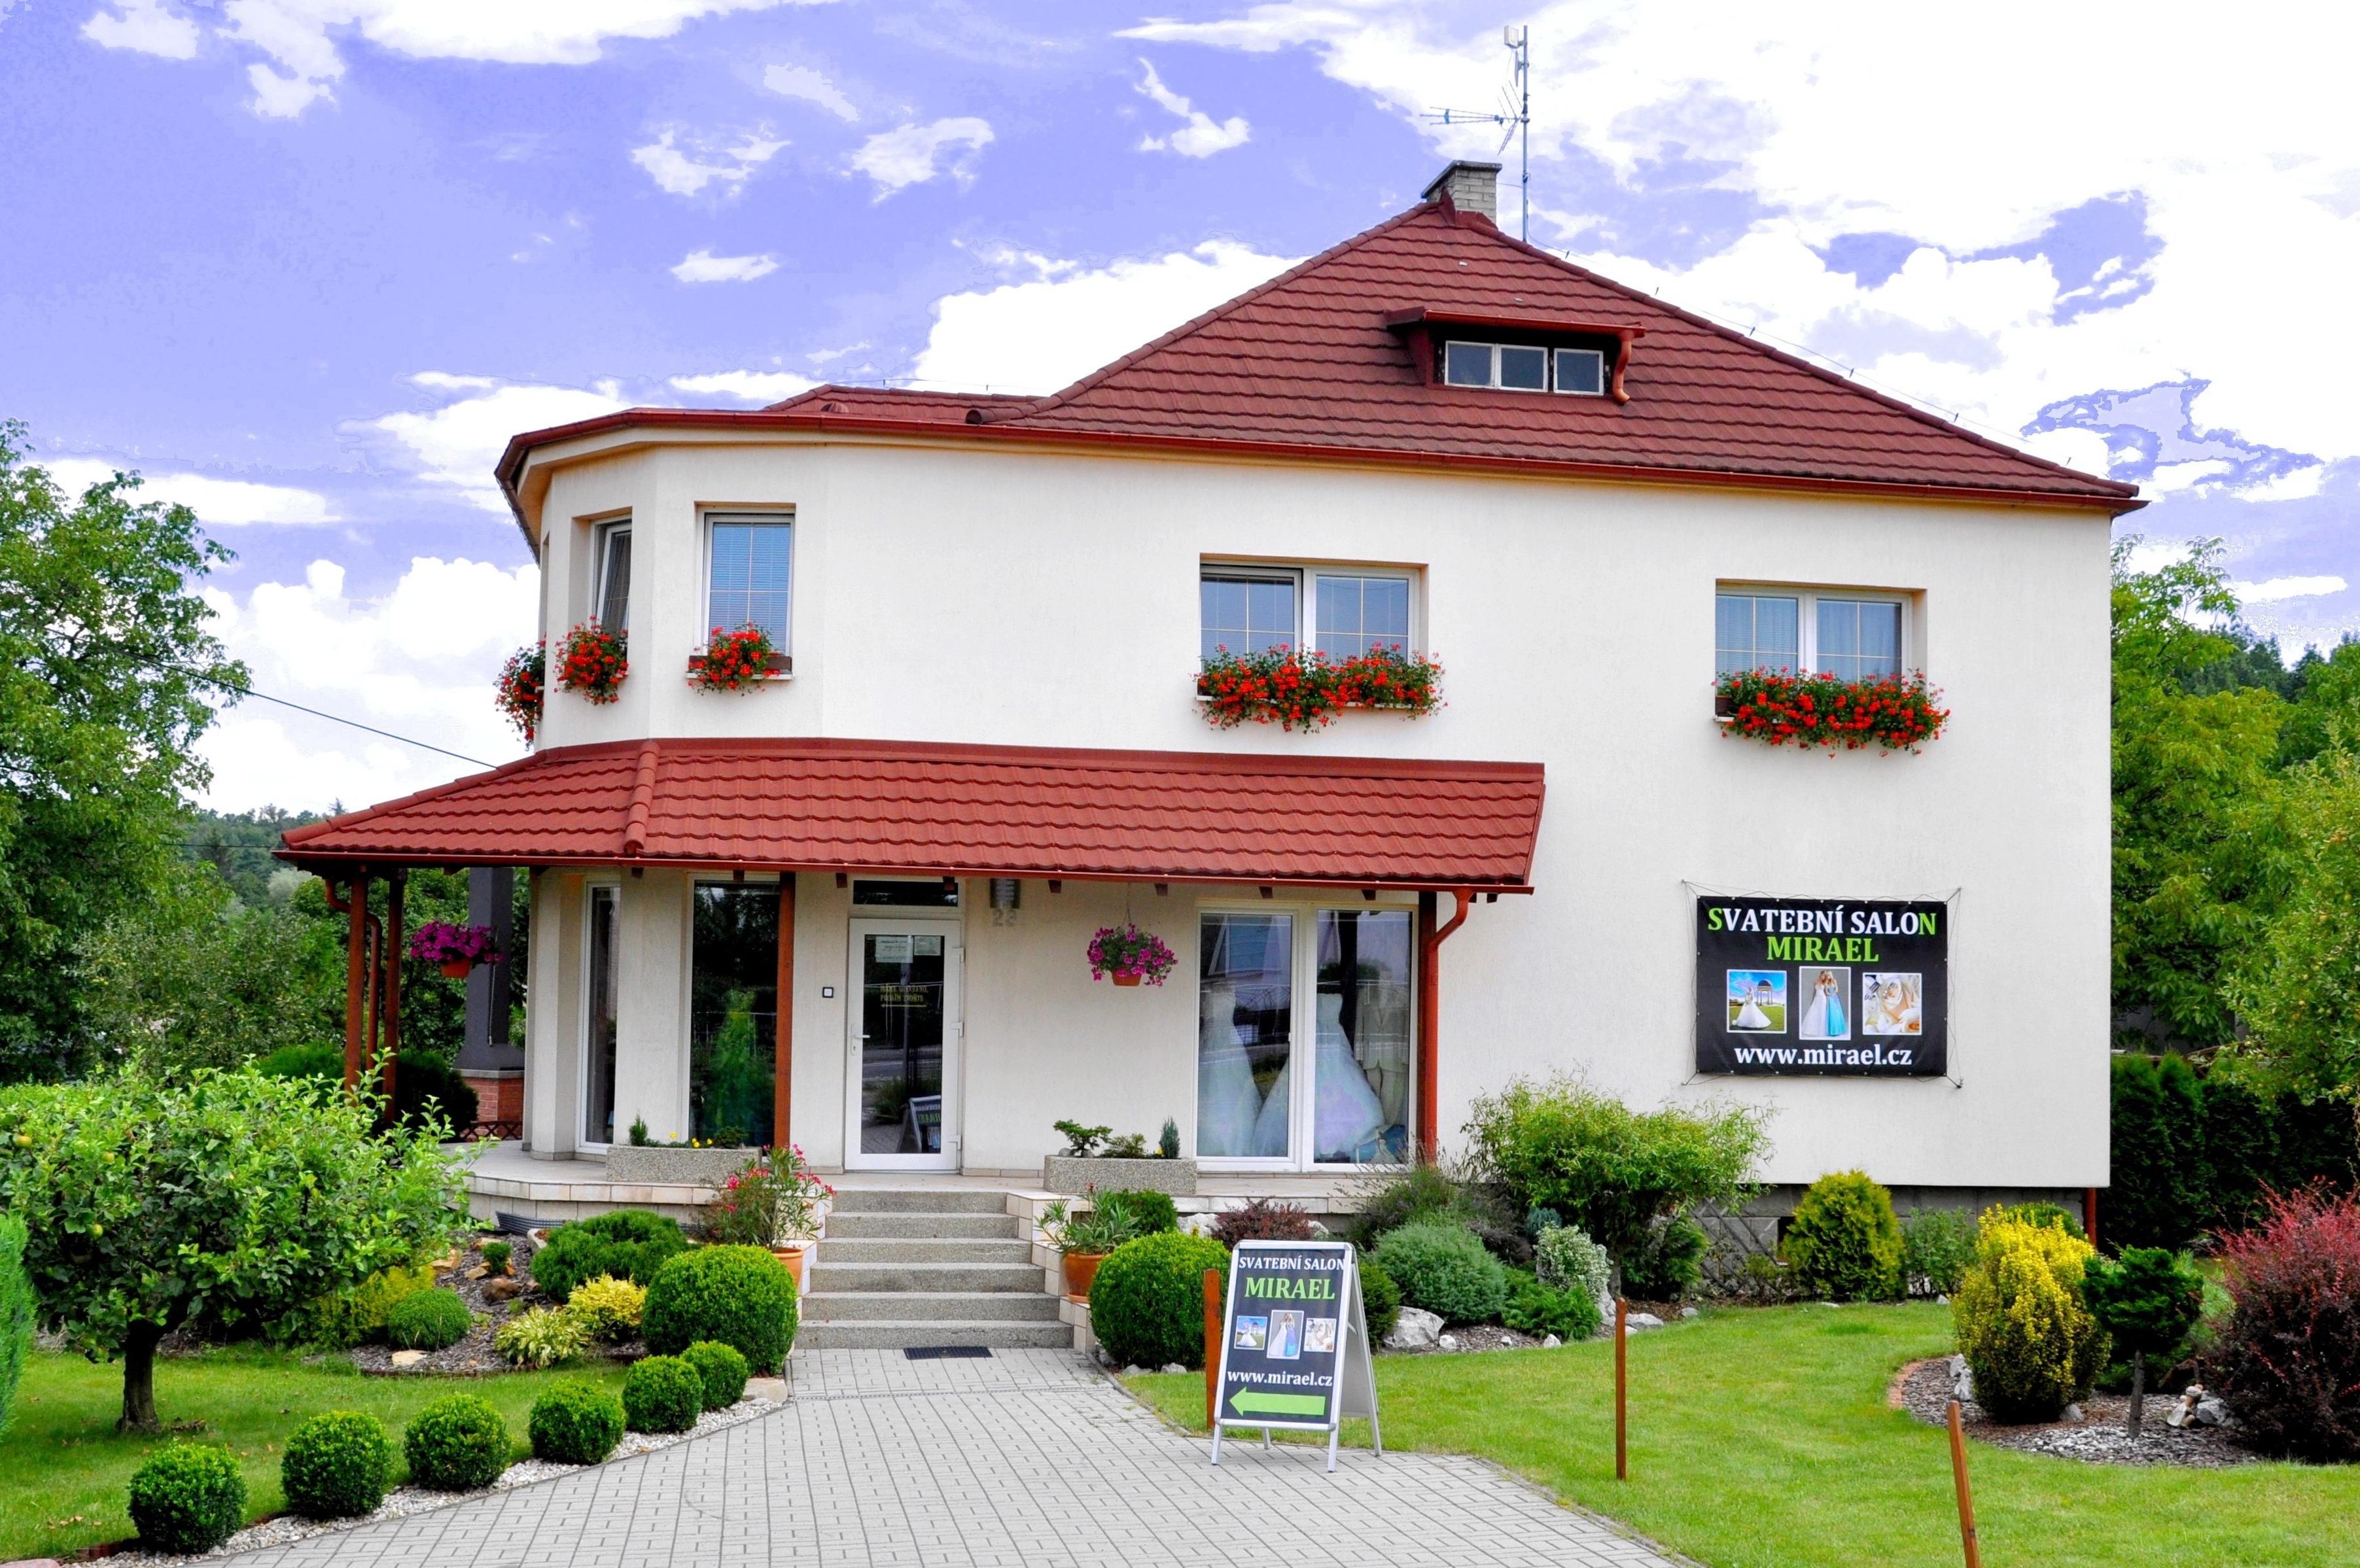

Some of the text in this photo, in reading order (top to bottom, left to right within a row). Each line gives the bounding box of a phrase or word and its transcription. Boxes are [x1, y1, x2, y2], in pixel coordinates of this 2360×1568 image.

[1708, 905, 1937, 935] SVATEBNÍ SALON
[1767, 936, 1880, 962] MIRAEL
[1734, 1044, 1912, 1066] www.mirael.cz
[1239, 1255, 1345, 1270] SVATEBNÍ SALON
[1244, 1277, 1335, 1300] MIRAEL
[1227, 1370, 1333, 1387] www.mirael.cz
